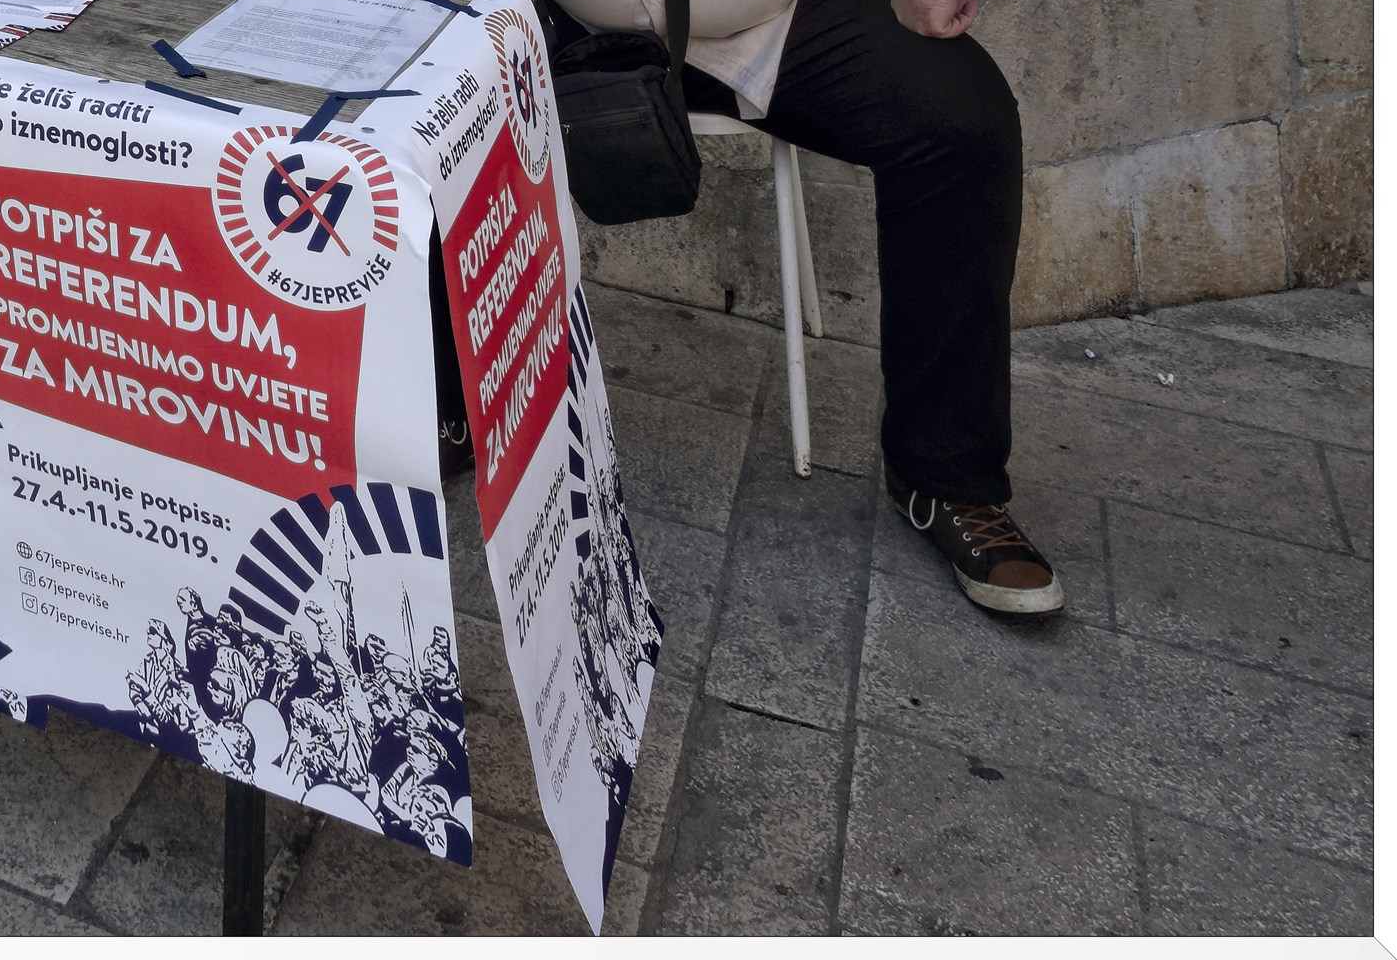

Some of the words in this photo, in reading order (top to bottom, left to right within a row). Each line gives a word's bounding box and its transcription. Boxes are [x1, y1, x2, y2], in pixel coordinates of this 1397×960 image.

[11, 112, 194, 168] iznemoglosti?
[16, 82, 73, 110] želiš
[79, 97, 153, 124] raditi
[411, 120, 440, 147] Ne
[428, 94, 459, 131] želiš
[453, 68, 480, 111] raditi
[439, 151, 452, 182] do
[447, 85, 500, 169] iznemoglosti?
[264, 154, 352, 253] 67
[458, 195, 502, 293] POTPIŠI
[500, 182, 518, 234] ZA
[129, 226, 182, 271] ZA
[267, 252, 392, 305] #67JEPREVIŠE
[467, 201, 549, 357] REFERENDUM,
[478, 291, 536, 416] PROMIJENIMO
[535, 245, 562, 301] UVJETE
[64, 357, 327, 472] MIROVINU!
[211, 362, 329, 422] UVJETE
[485, 418, 505, 485] ZA
[504, 295, 565, 447] MIROVINU!
[7, 443, 134, 501] Prikupljanje
[140, 490, 232, 532] potpisa:
[11, 476, 219, 564] 27.4.-11.5.2019.
[35, 551, 126, 590] 67jeprevise.hr
[508, 510, 544, 601] Prikupljanje
[544, 463, 566, 527] potpisa:
[38, 575, 110, 610] 67jepreviše
[515, 507, 569, 649] 27.4.-11.5.2019.
[40, 602, 130, 644] 67jeprevise.hr
